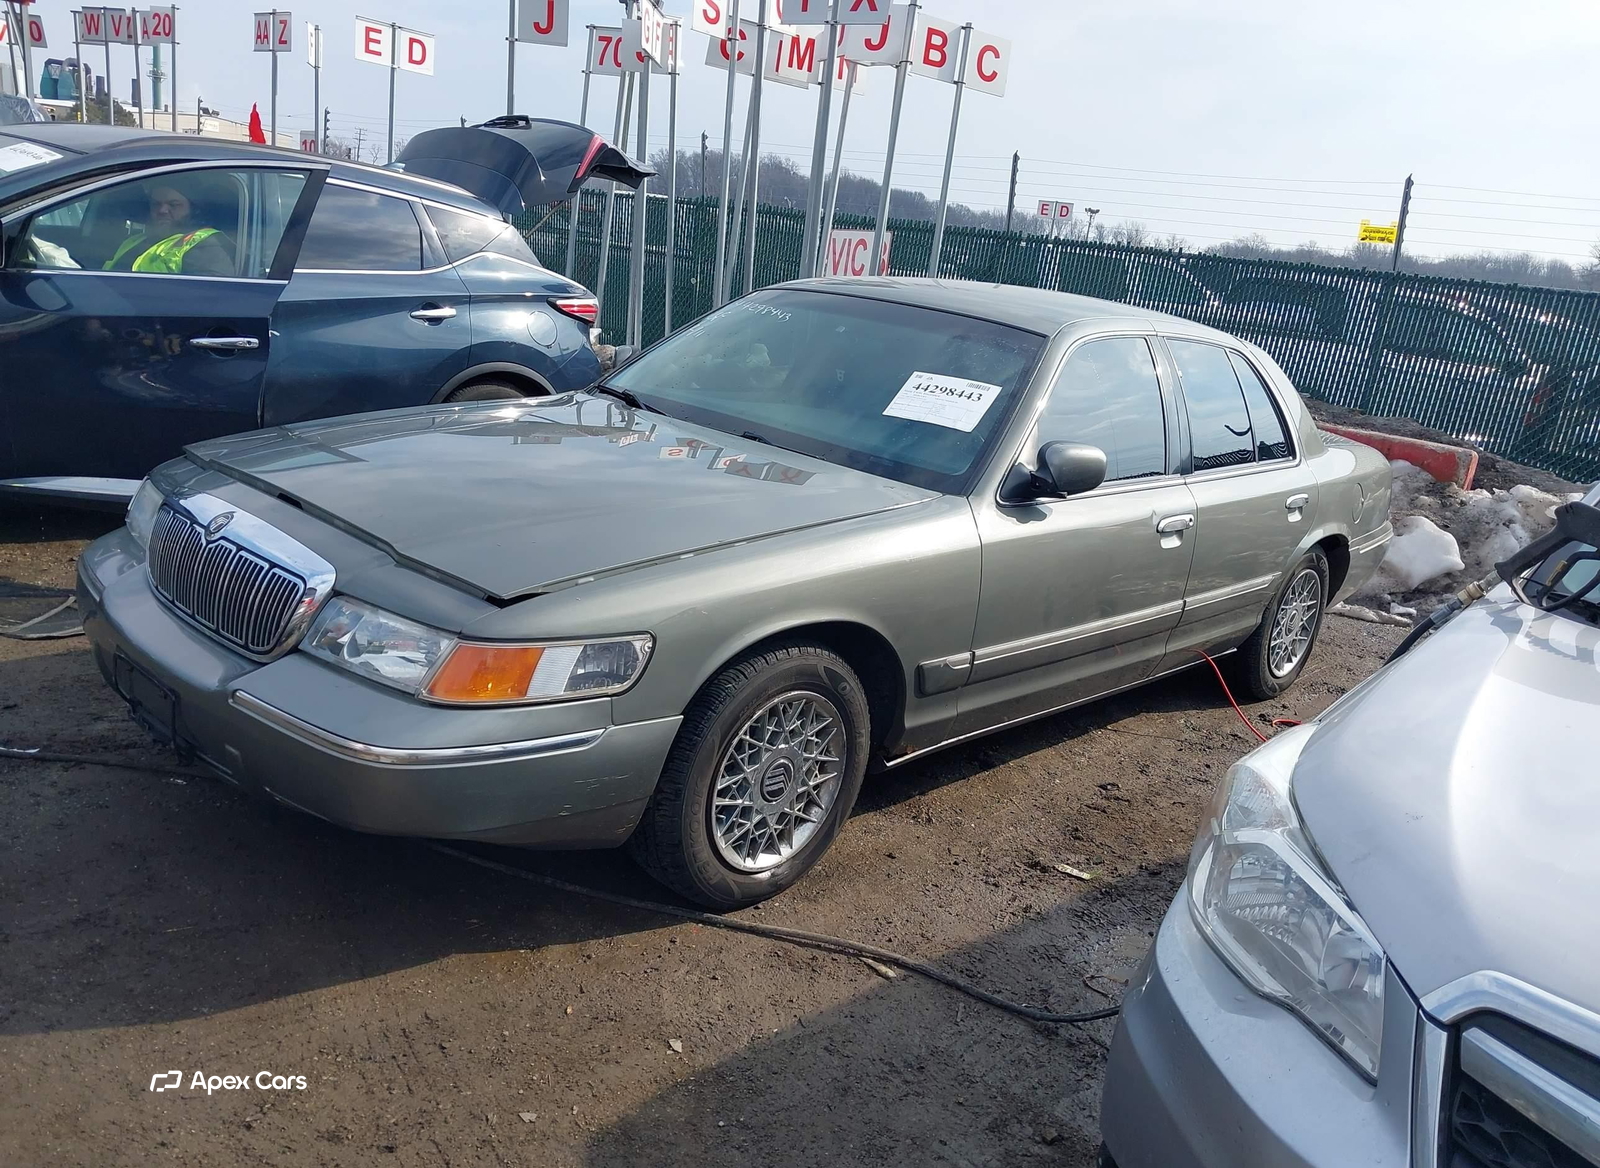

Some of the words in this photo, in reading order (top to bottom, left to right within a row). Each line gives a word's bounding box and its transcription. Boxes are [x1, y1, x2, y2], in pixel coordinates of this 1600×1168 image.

[84, 13, 100, 36] W
[111, 14, 122, 37] V
[152, 12, 172, 37] 20
[255, 20, 270, 45] AA
[278, 19, 288, 45] Z
[364, 26, 382, 56] E
[408, 37, 427, 66] D
[922, 27, 948, 68] B
[787, 35, 816, 73] M
[976, 45, 1000, 82] C
[1041, 203, 1050, 216] E
[1059, 205, 1070, 218] D
[912, 382, 983, 402] 44298443
